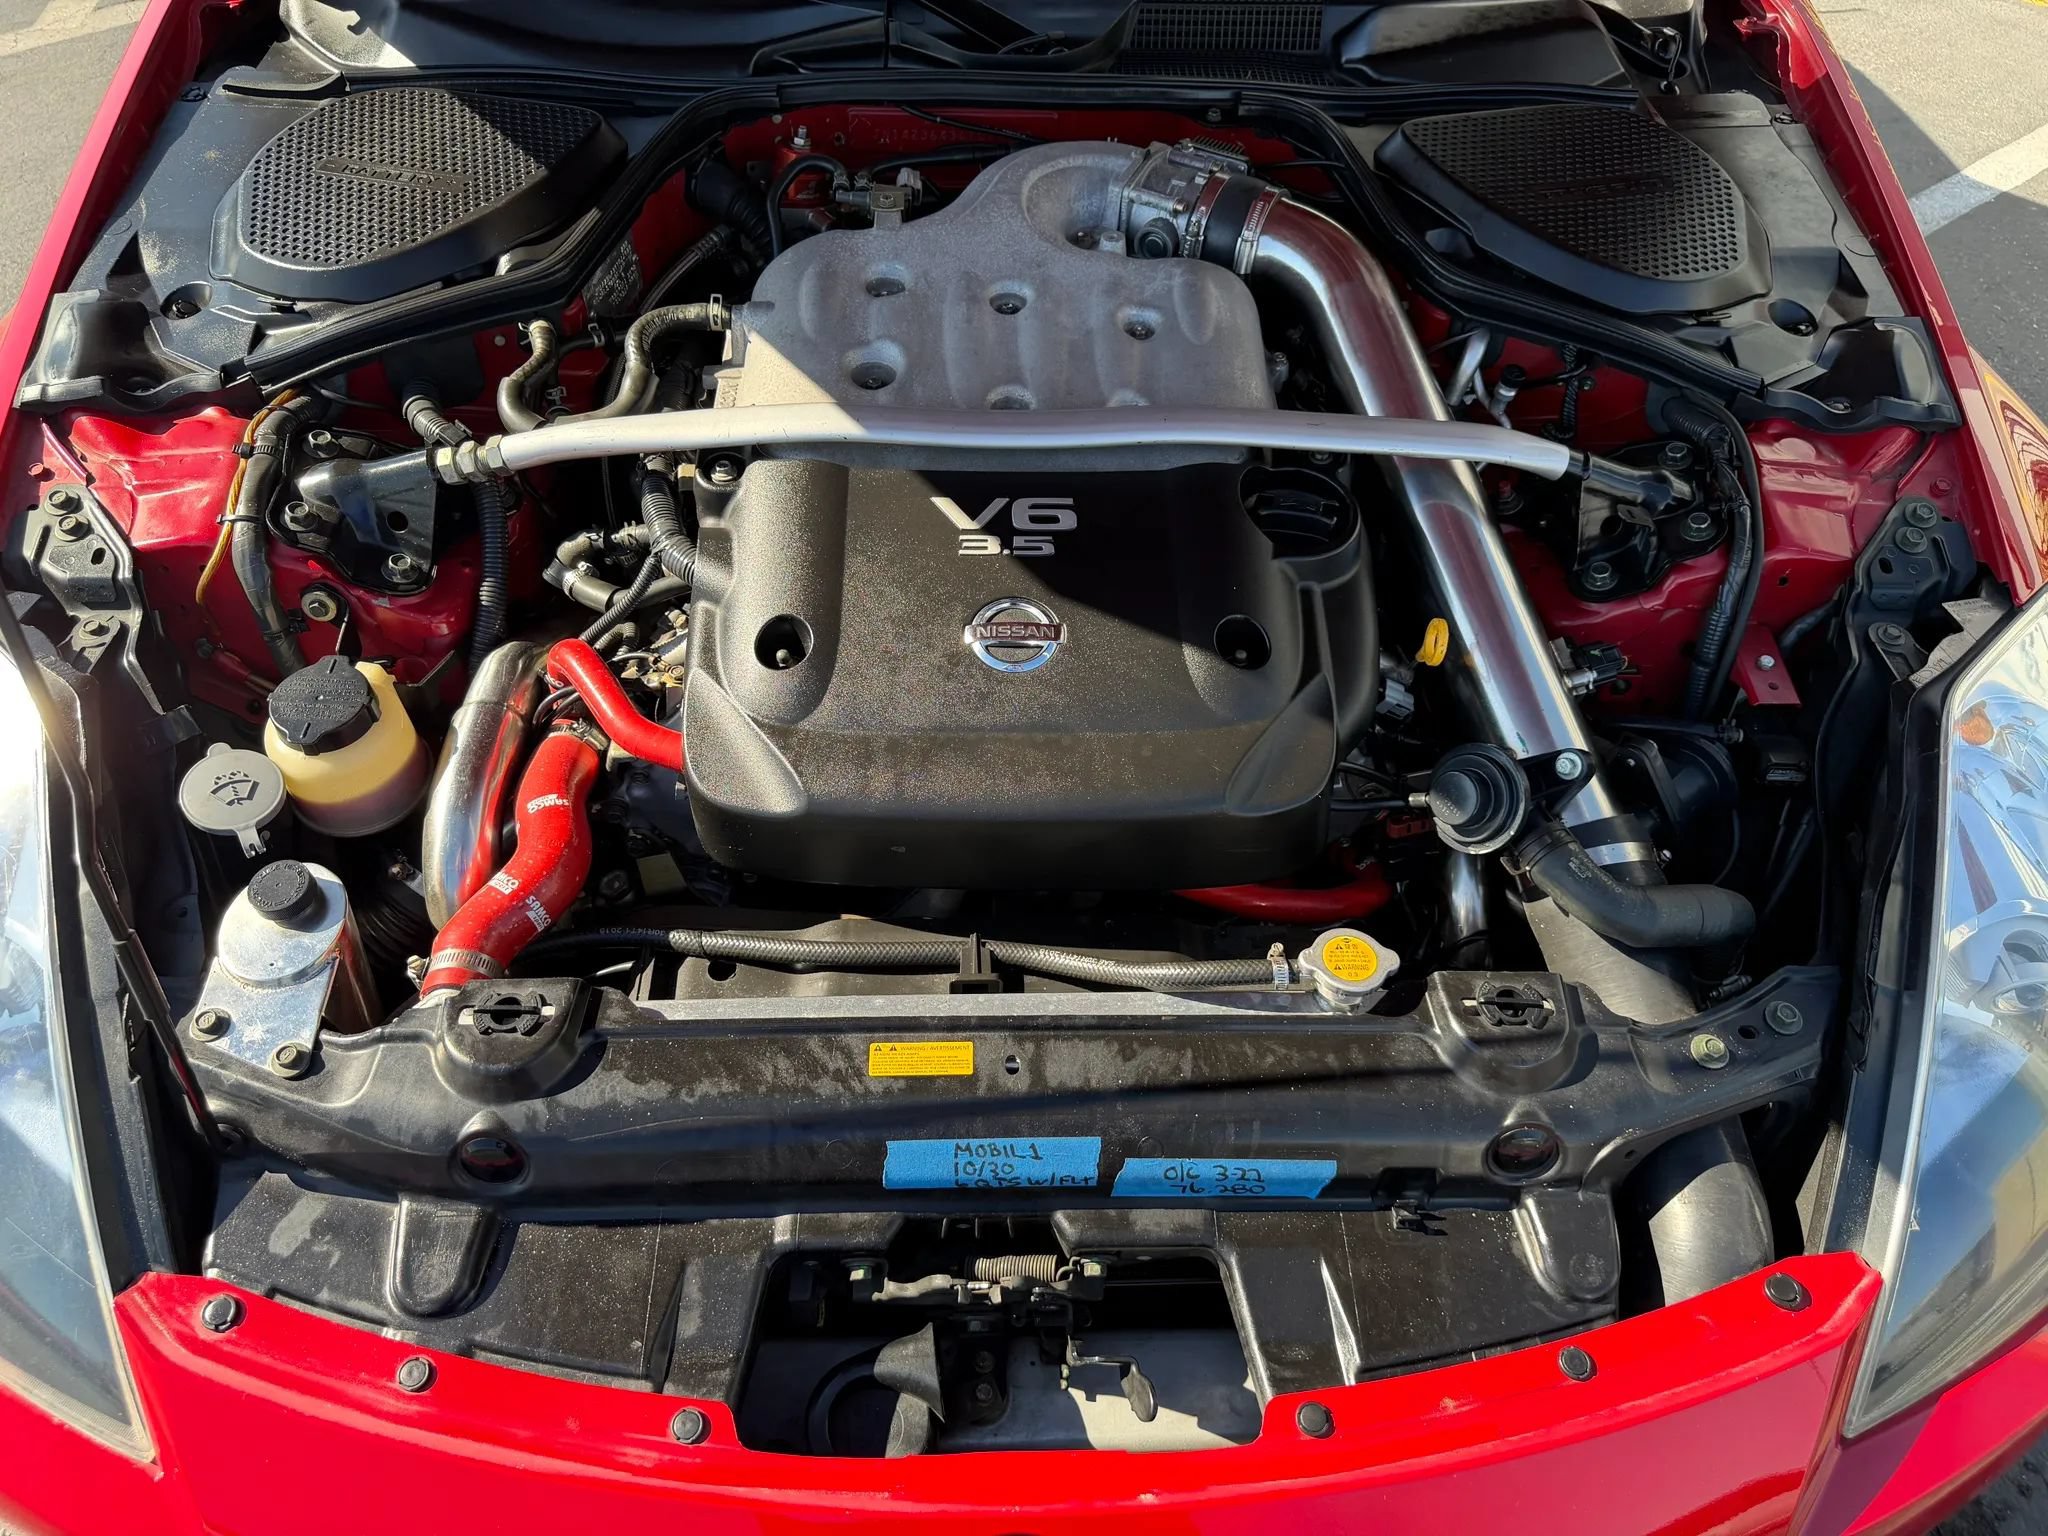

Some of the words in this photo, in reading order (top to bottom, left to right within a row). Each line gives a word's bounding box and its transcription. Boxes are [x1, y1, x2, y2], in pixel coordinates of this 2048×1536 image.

[930, 496, 1077, 531] V6
[958, 535, 1056, 557] 3.5
[975, 625, 1055, 638] NISSAN
[525, 895, 552, 927] SAMCO
